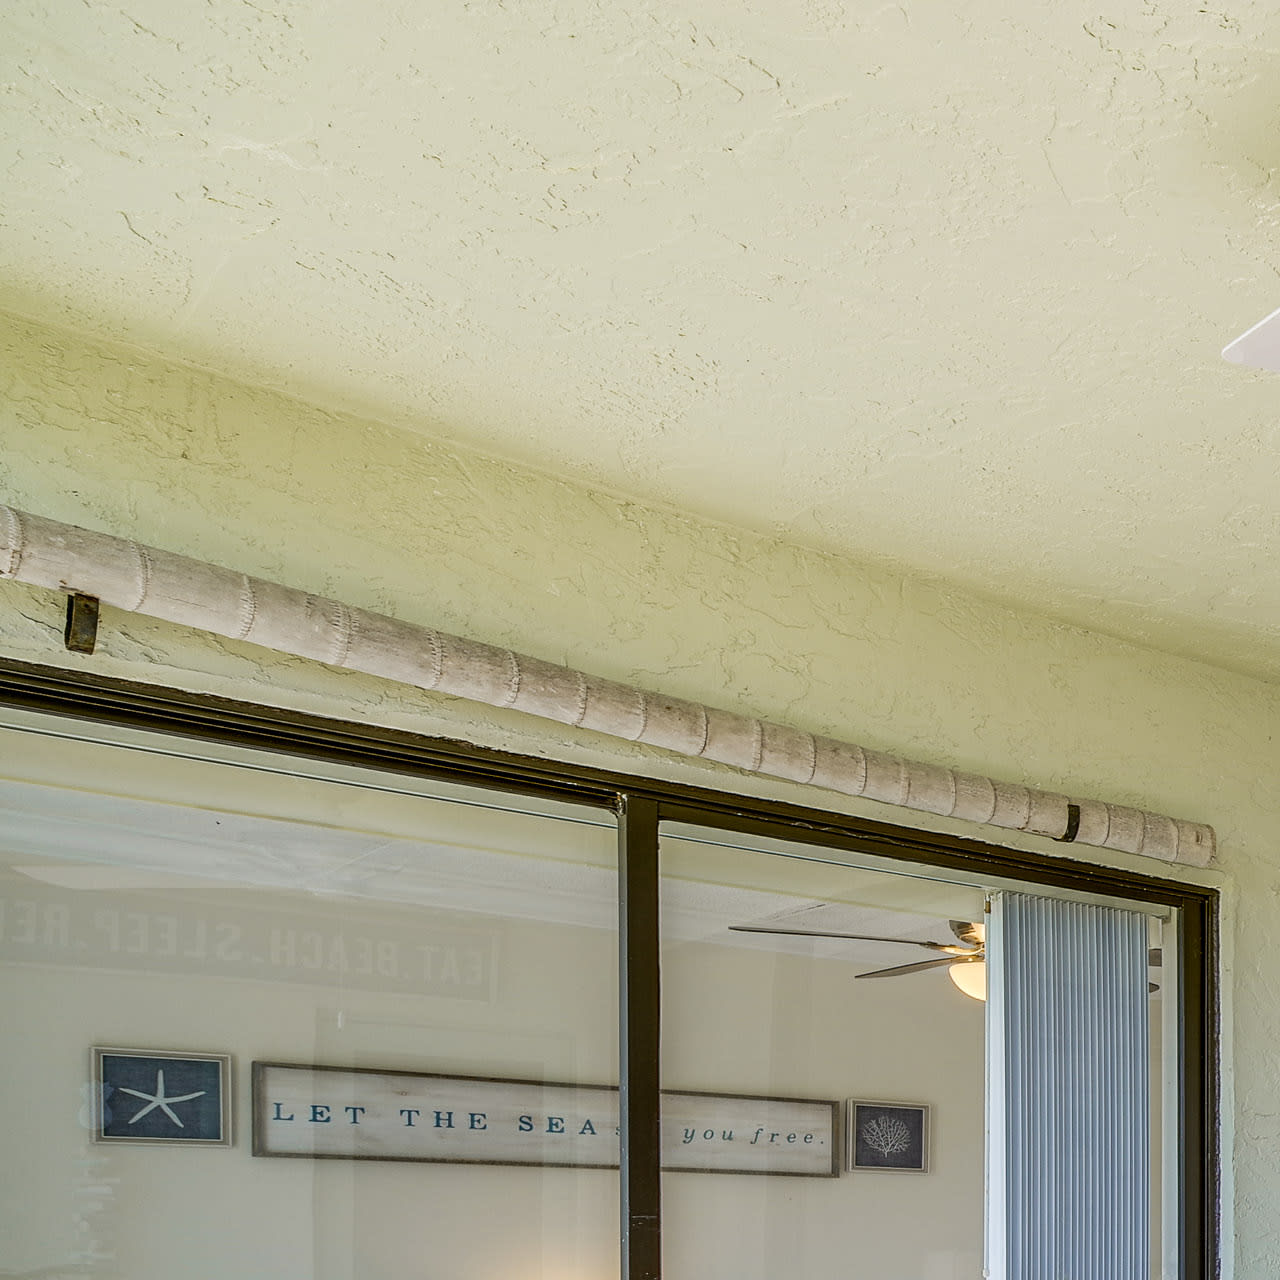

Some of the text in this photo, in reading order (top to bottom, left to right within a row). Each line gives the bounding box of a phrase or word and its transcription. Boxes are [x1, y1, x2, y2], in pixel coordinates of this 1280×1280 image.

[272, 1102, 366, 1125] LET
[400, 1109, 488, 1130] THE
[518, 1115, 597, 1136] SEA
[682, 1127, 825, 1145] you free.
